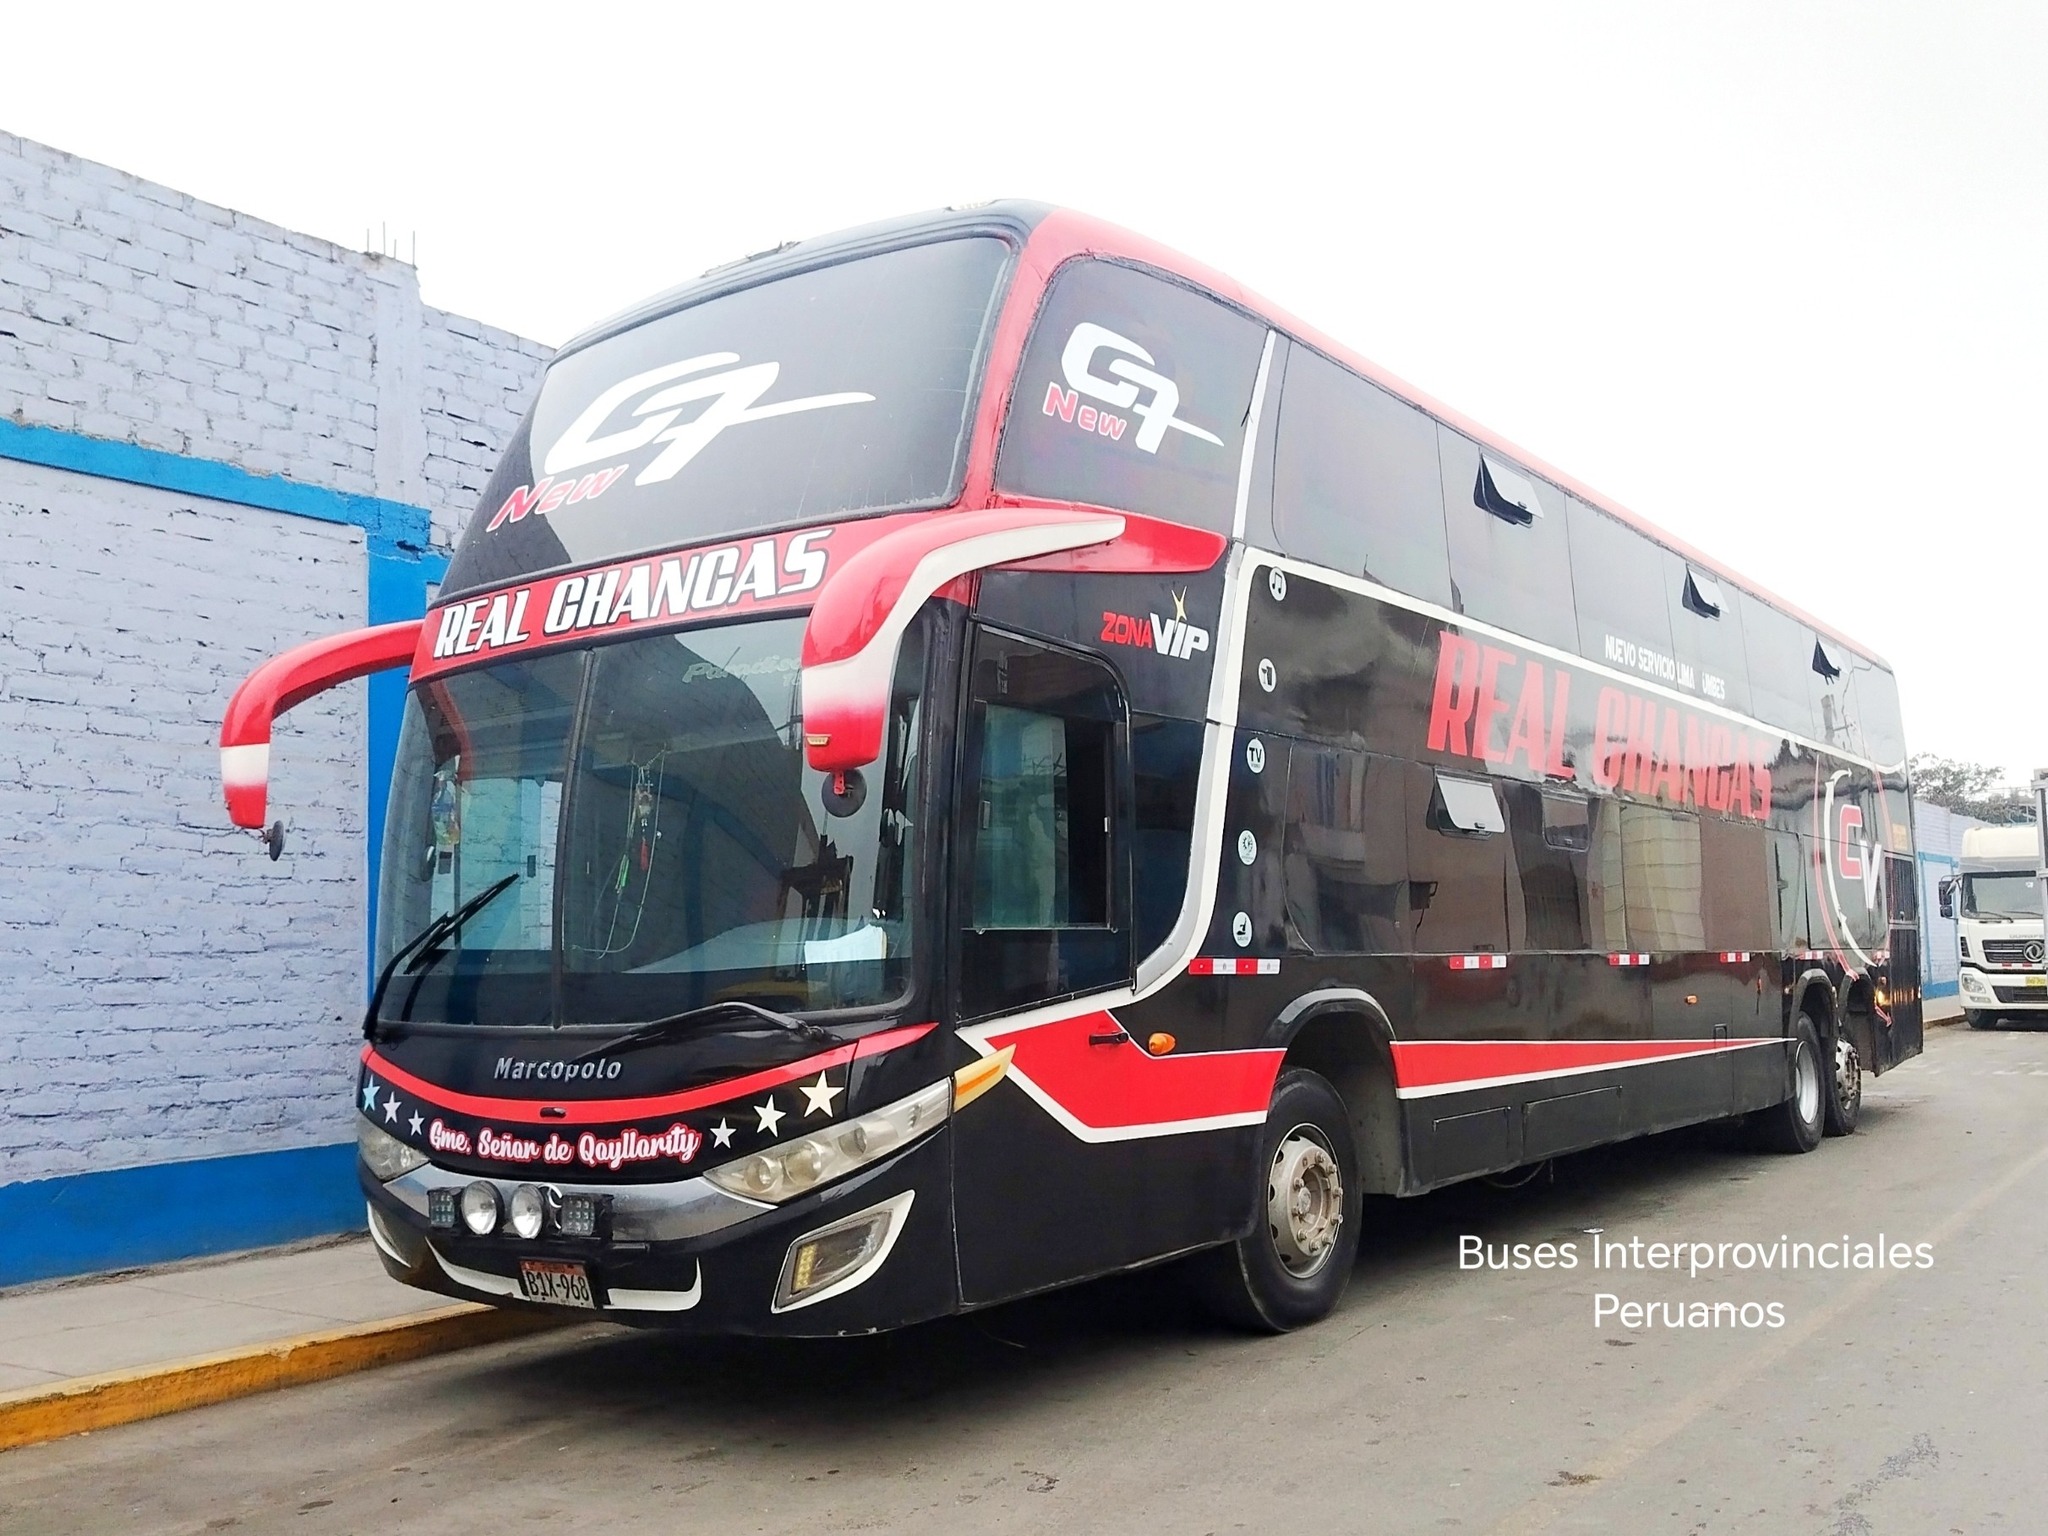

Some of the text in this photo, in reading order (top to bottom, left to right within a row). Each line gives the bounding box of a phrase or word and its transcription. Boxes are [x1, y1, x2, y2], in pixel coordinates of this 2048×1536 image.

[1042, 381, 1127, 441] New
[485, 464, 629, 532] New
[433, 589, 531, 659] REAL
[1101, 611, 1210, 660] ZONA VIP
[1605, 634, 1636, 667] NUEVO
[1638, 647, 1675, 681] SERVICIO
[1677, 662, 1695, 690] LIMA
[1427, 631, 1576, 778] REAL
[1249, 747, 1262, 763] TV
[495, 1057, 622, 1082] Marcopolo
[544, 1133, 573, 1162] de
